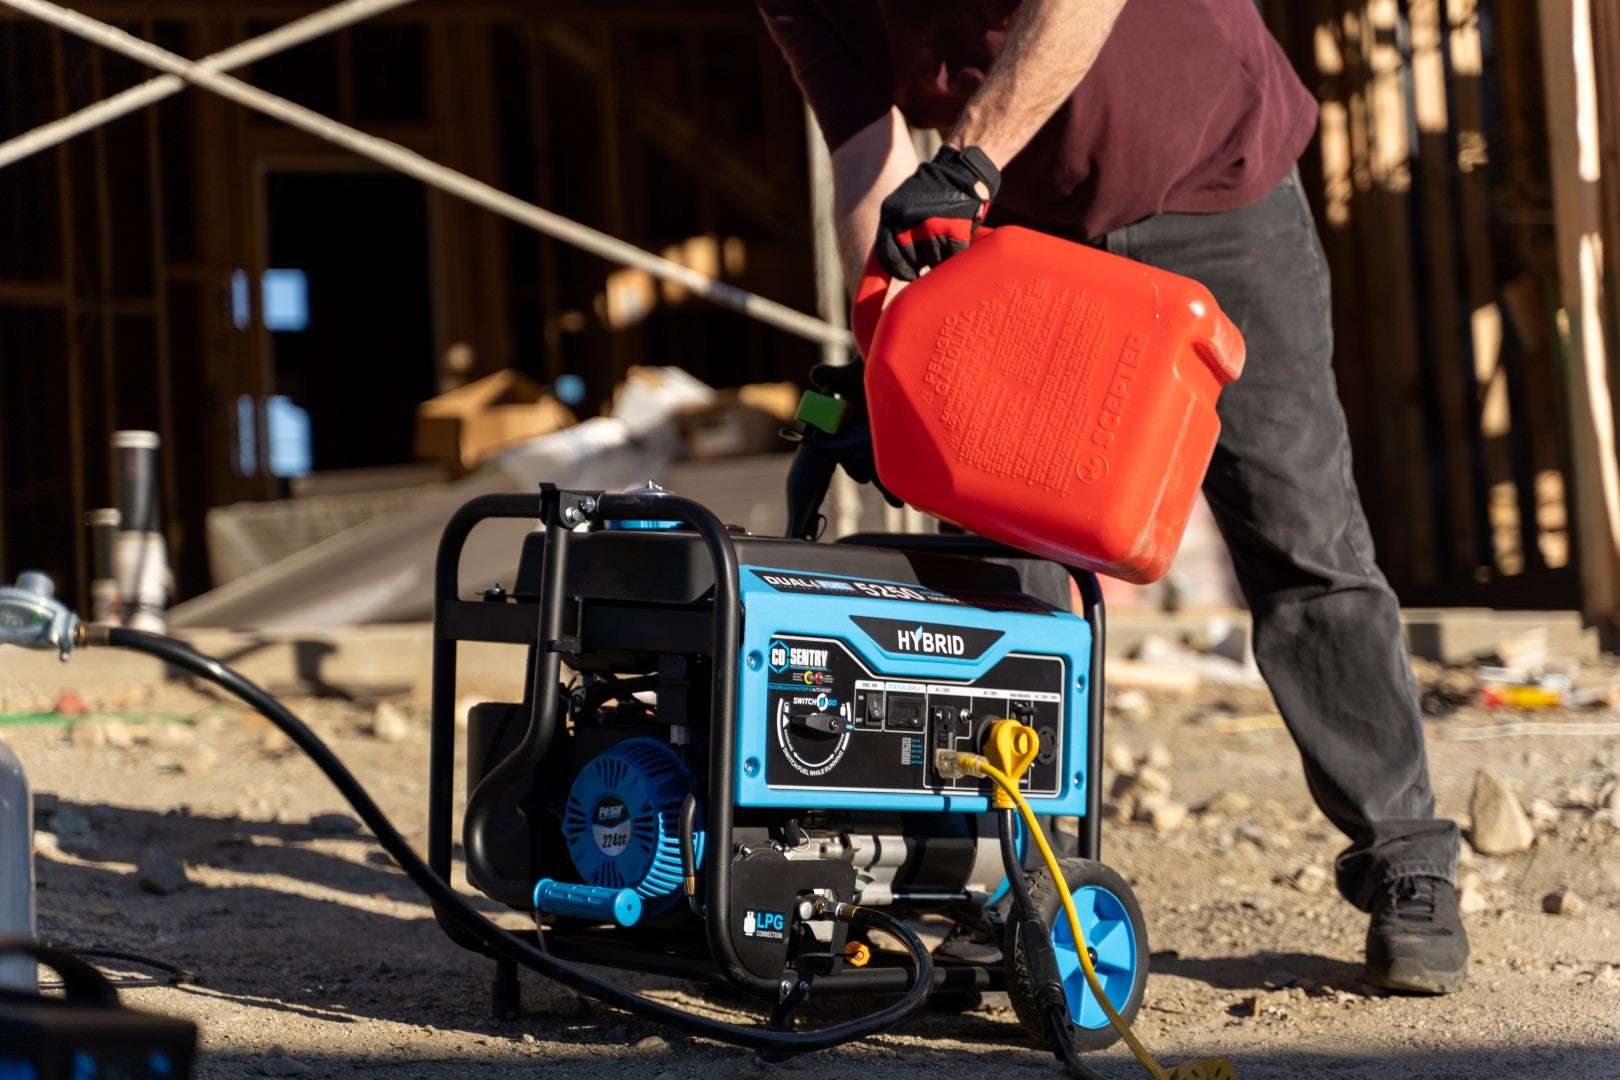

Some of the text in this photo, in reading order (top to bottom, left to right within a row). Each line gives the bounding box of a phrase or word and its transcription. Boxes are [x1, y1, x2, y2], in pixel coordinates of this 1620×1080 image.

[922, 314, 957, 384] PELIGRO
[934, 308, 976, 396] GASOLINA
[1091, 331, 1149, 448] SCEPTER
[762, 575, 813, 588] DUAL
[853, 582, 926, 600] 5250
[897, 626, 965, 655] HYBRID
[771, 648, 828, 667] CO SENTRY
[793, 697, 817, 706] SWITCH
[757, 912, 784, 930] LPG
[756, 930, 783, 939] CONNECTION
